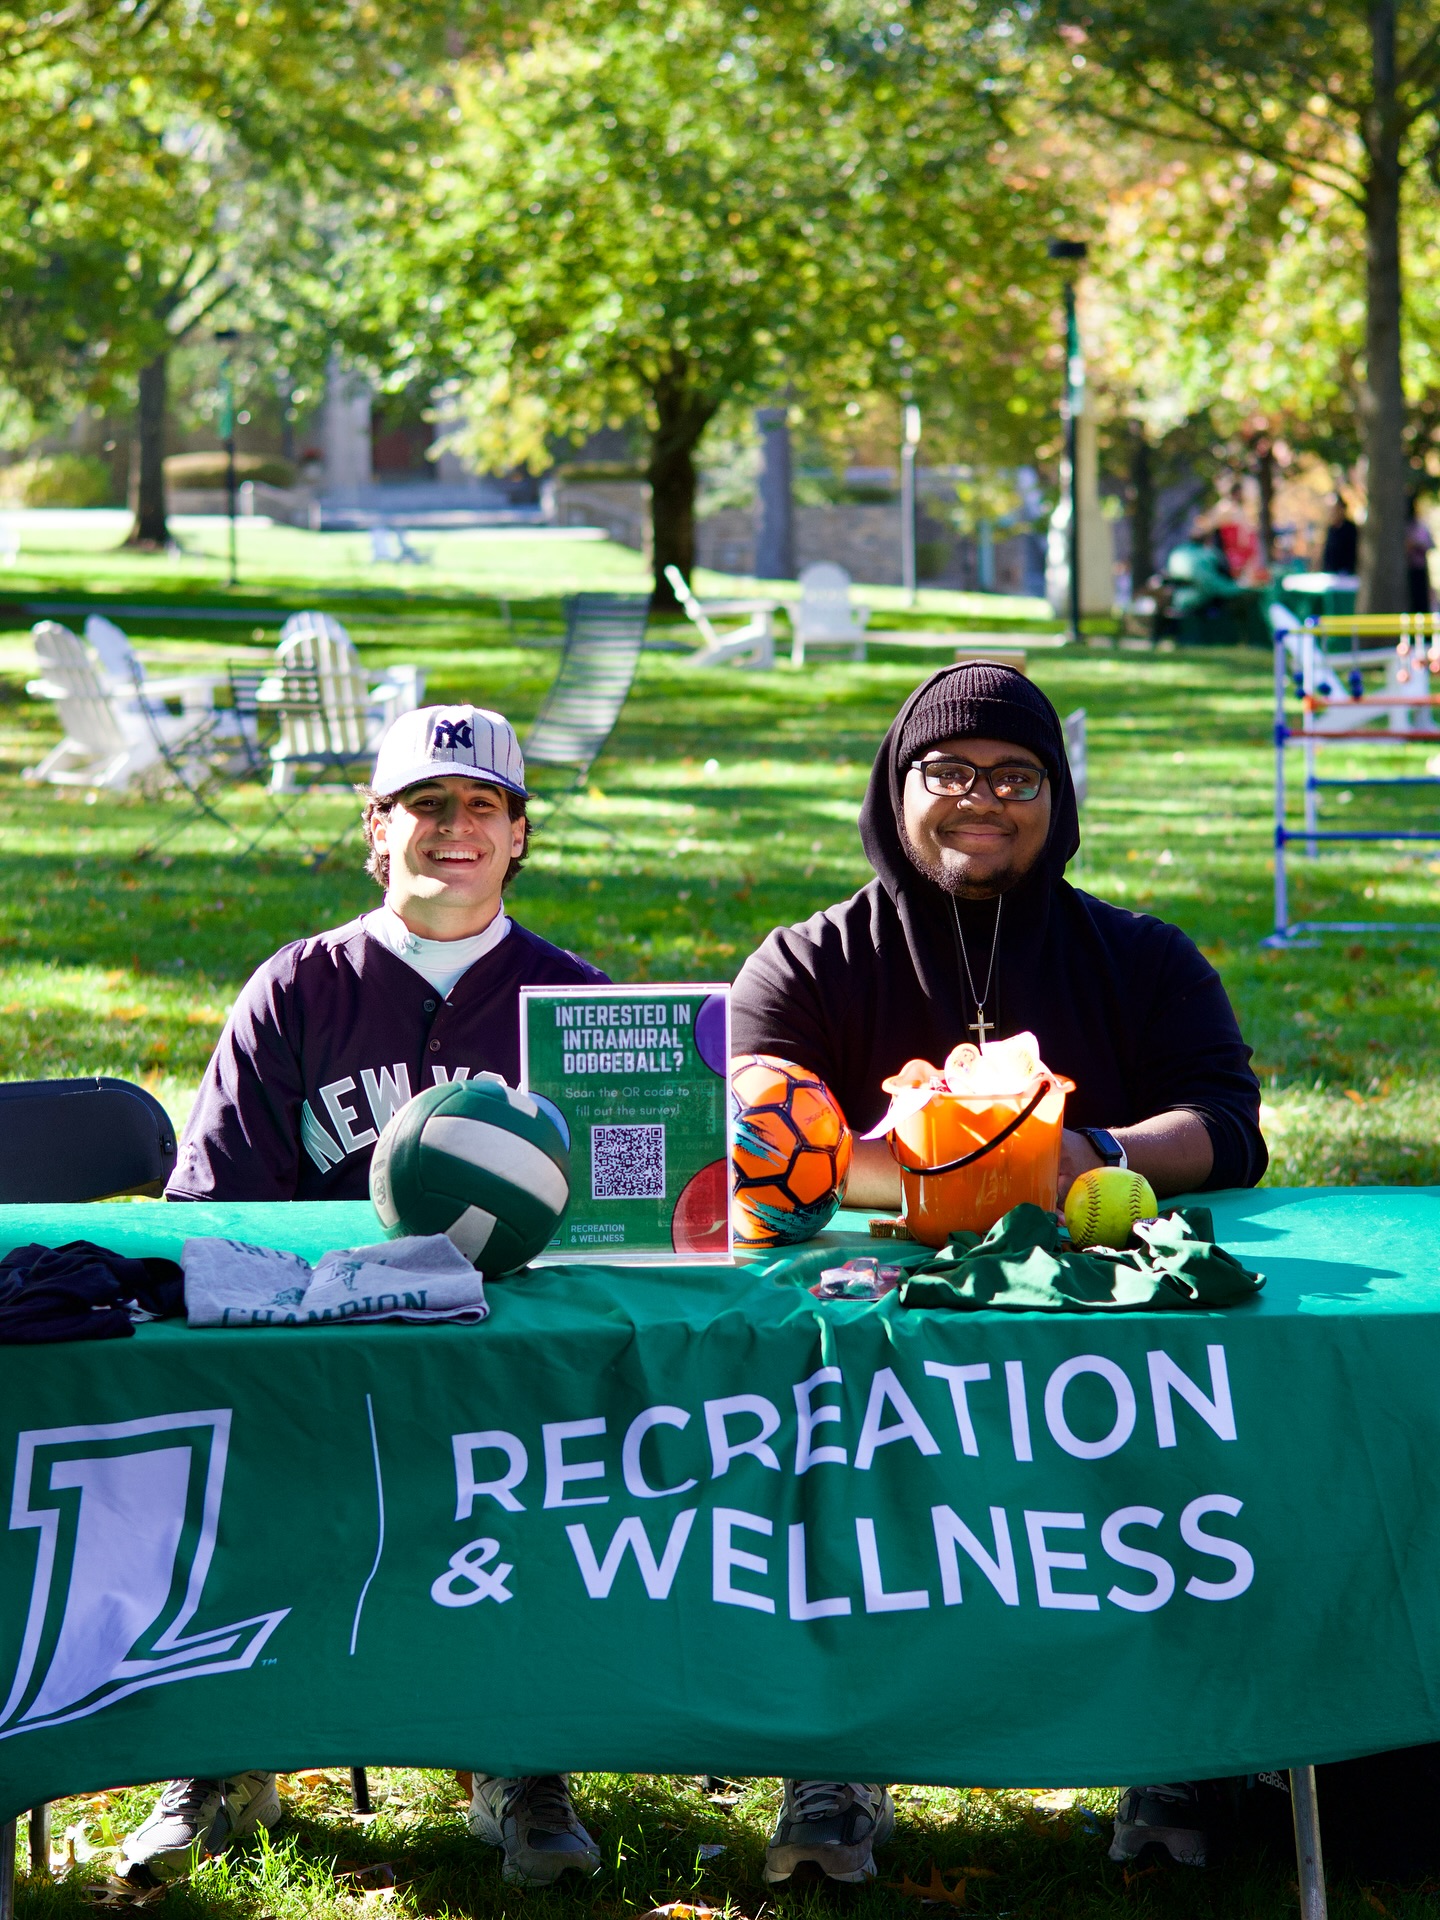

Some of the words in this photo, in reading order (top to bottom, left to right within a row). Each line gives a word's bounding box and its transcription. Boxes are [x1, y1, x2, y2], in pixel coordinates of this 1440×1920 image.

[434, 719, 473, 749] NY
[555, 1004, 667, 1027] INTERESTED
[672, 1003, 691, 1025] IN
[563, 1028, 684, 1051] INTRAMURAL
[563, 1051, 685, 1074] DODGEBALL?
[565, 1087, 595, 1099] Scan
[599, 1086, 618, 1098] the
[643, 1085, 674, 1097] code
[677, 1086, 690, 1097] to
[301, 1062, 412, 1175] NEW
[575, 1105, 590, 1117] fill
[593, 1107, 613, 1116] out
[616, 1104, 636, 1116] the
[639, 1104, 680, 1118] survey!
[570, 1224, 625, 1233] RECREATION
[570, 1234, 577, 1243] &
[579, 1234, 625, 1243] WELLNESS
[453, 1344, 1238, 1521] RECREATION
[431, 1537, 513, 1607] &
[565, 1494, 1256, 1621] WELLNESS
